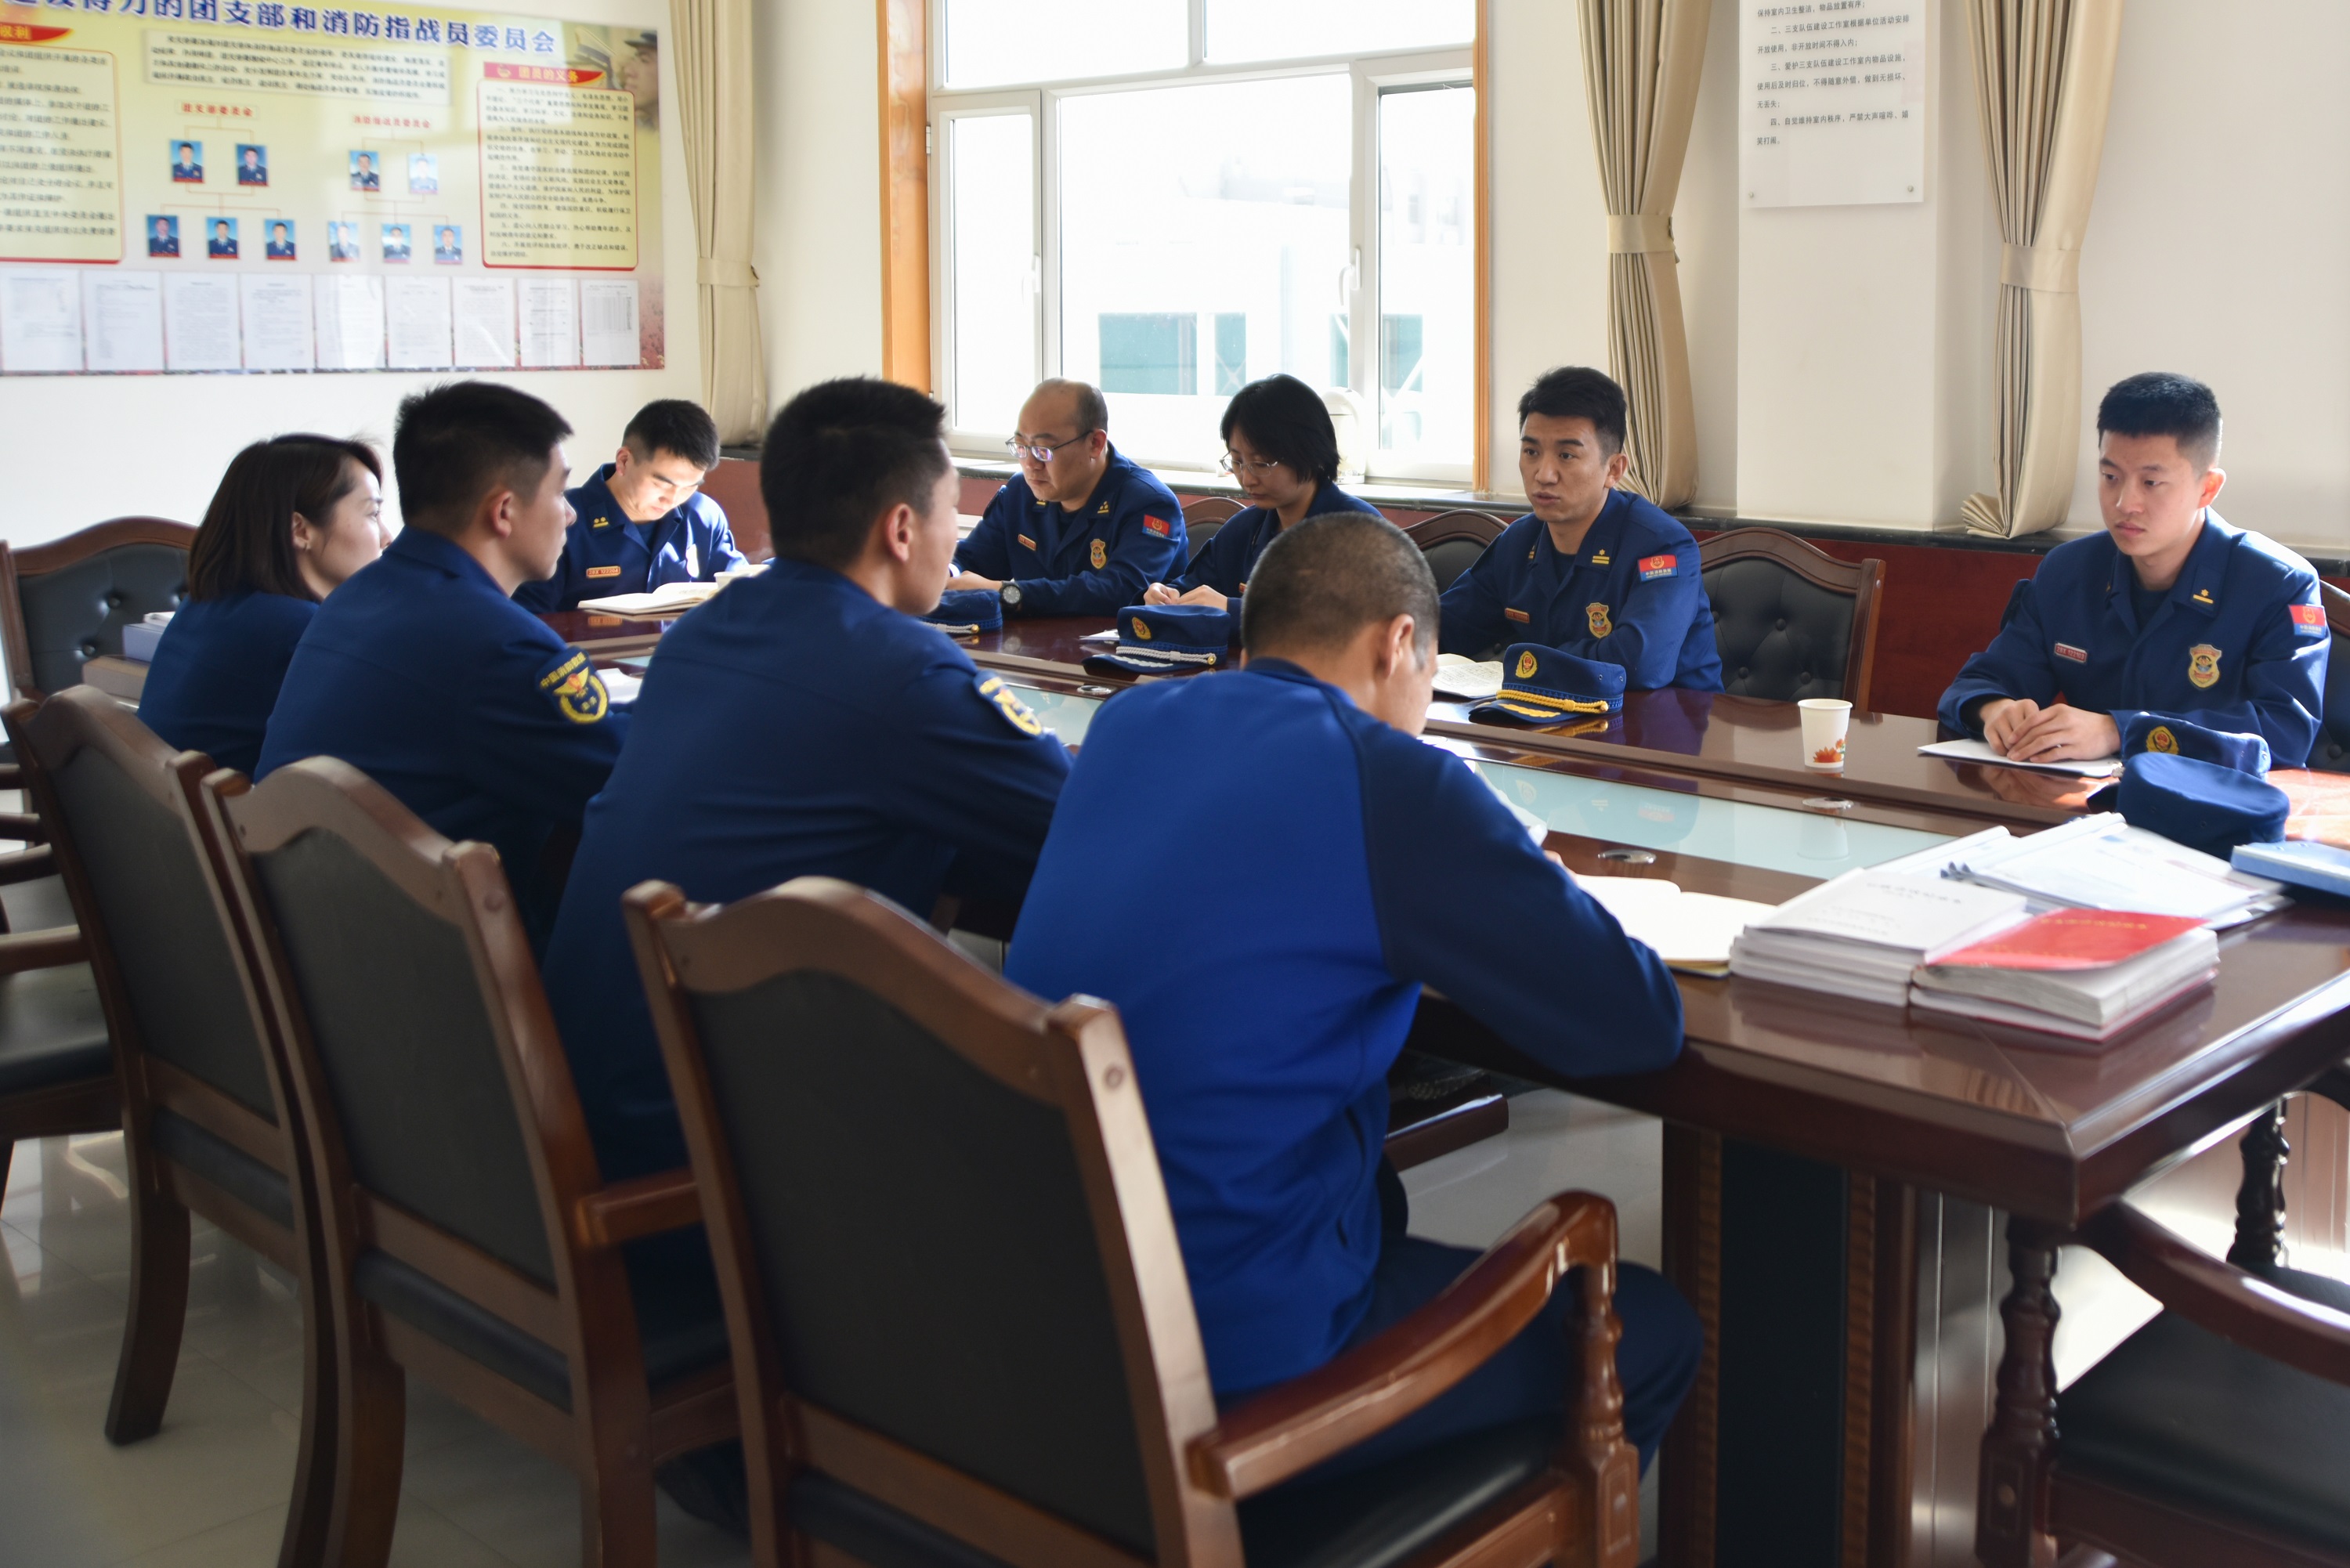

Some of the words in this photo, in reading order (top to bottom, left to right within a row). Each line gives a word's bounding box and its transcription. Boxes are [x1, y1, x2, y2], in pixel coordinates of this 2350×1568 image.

[1757, 0, 1865, 17] 保持室内卫生整洁,物品放置有序;
[1770, 14, 1910, 34] 二、三支队伍建设工作室根据单位活动安排
[1757, 38, 1858, 54] 开放使用,非开放时间不得入内;
[1770, 53, 1906, 71] 三、爱护三支队伍建设工作室内物品设施,
[1757, 100, 1781, 109] 无丢失;
[1756, 136, 1781, 146] 笑打闹。
